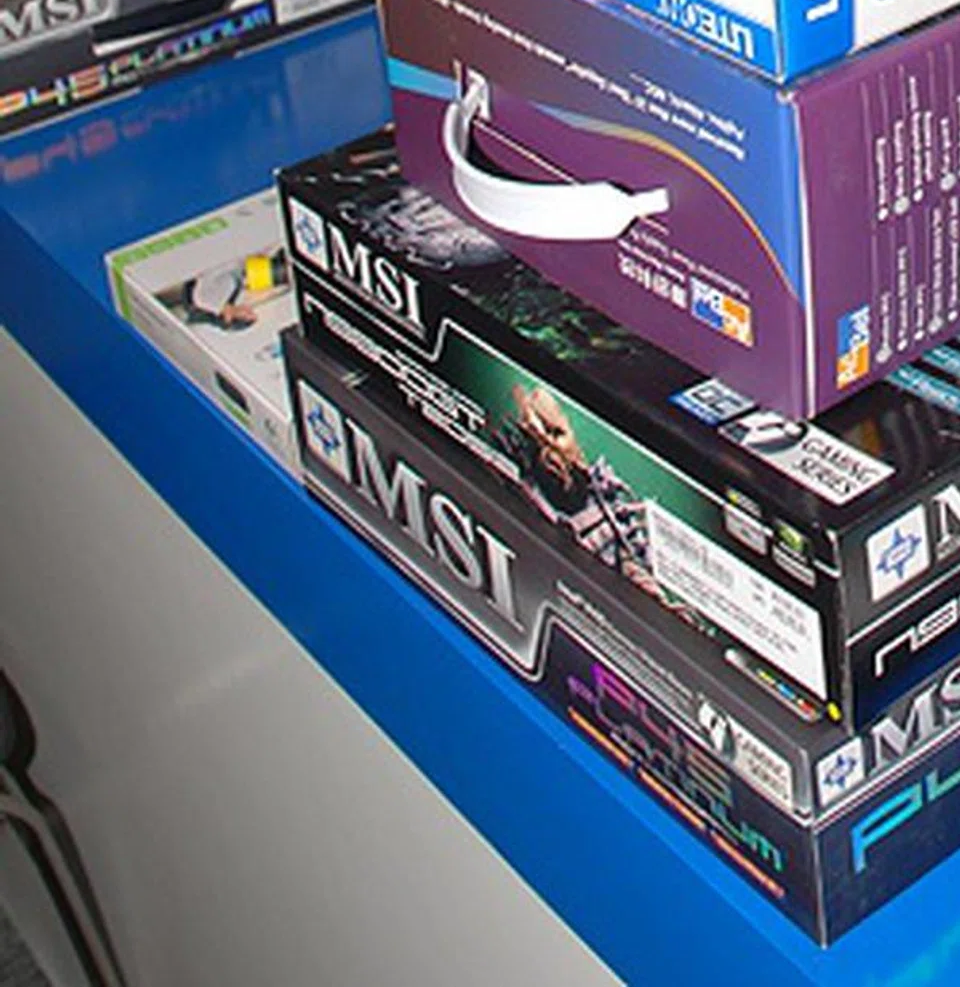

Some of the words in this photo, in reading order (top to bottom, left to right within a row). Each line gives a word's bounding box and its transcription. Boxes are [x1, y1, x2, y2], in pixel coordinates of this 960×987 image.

[327, 221, 428, 340] MSI
[795, 454, 860, 498] SERIES
[801, 432, 882, 487] GAMING
[346, 416, 525, 634] MSI
